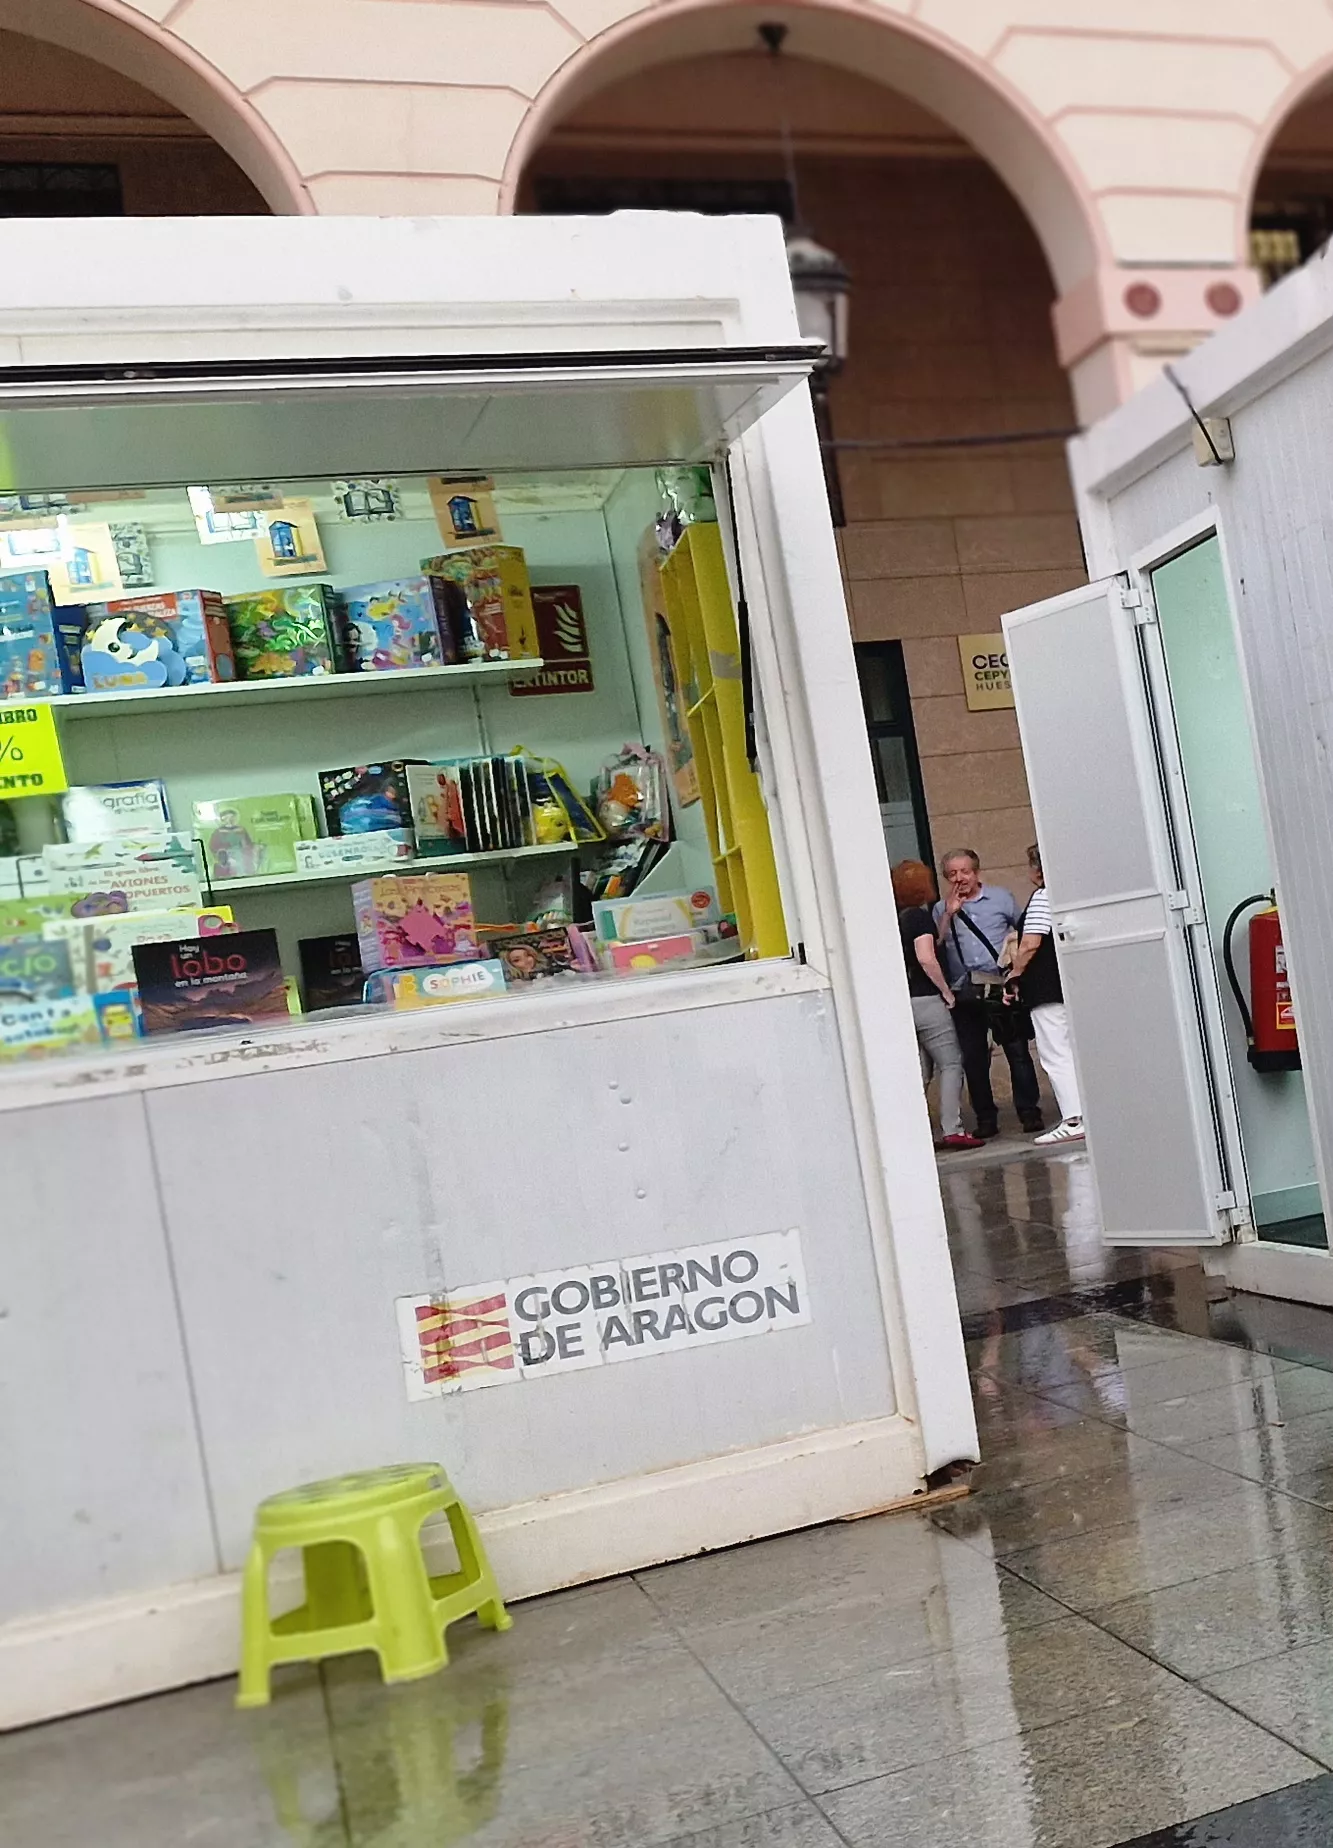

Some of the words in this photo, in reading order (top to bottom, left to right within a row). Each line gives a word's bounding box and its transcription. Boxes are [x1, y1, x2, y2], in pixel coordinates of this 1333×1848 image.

[974, 670, 1009, 681] CEPY
[976, 681, 1012, 691] HUES
[0, 708, 37, 724] BRO
[0, 773, 43, 789] NTO
[111, 875, 168, 888] AVIONES
[125, 885, 191, 899] OPUERTOS
[178, 944, 200, 955] Hay
[170, 950, 246, 977] lobo
[174, 978, 189, 987] en
[189, 976, 201, 985] la
[429, 970, 486, 990] SOPHIE
[514, 1249, 760, 1323] GOBIERNO
[518, 1322, 585, 1367] DE
[600, 1280, 801, 1350] ARAGON
